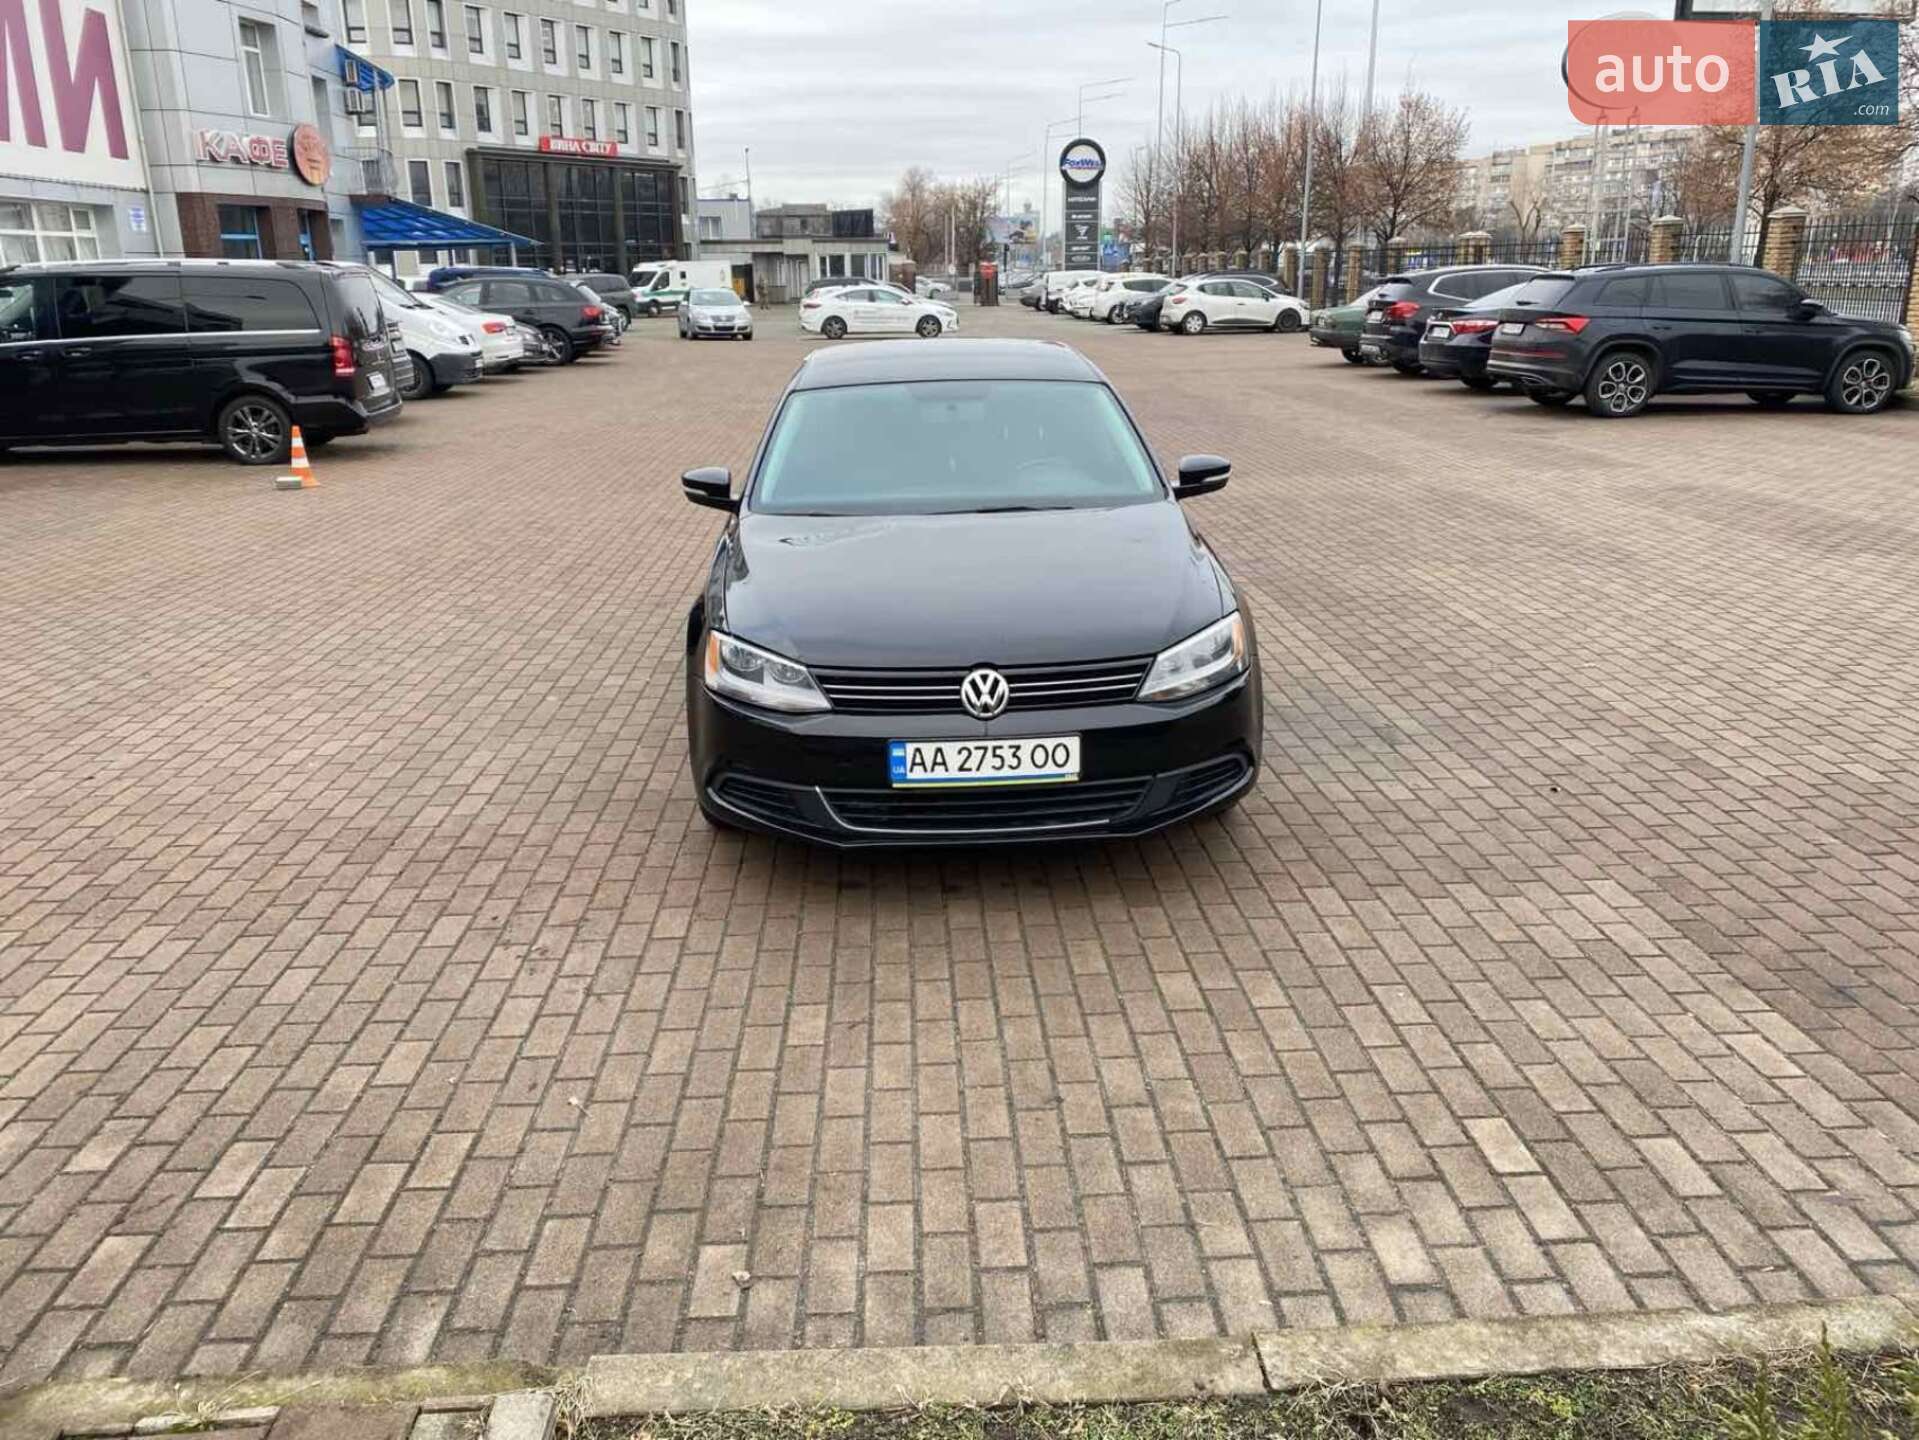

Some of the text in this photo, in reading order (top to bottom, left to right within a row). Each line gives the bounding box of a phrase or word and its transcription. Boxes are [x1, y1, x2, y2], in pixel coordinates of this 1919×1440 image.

[196, 128, 288, 168] КАФЕ
[892, 765, 905, 775] UA
[909, 746, 949, 773] AA
[957, 744, 1022, 772] 2753
